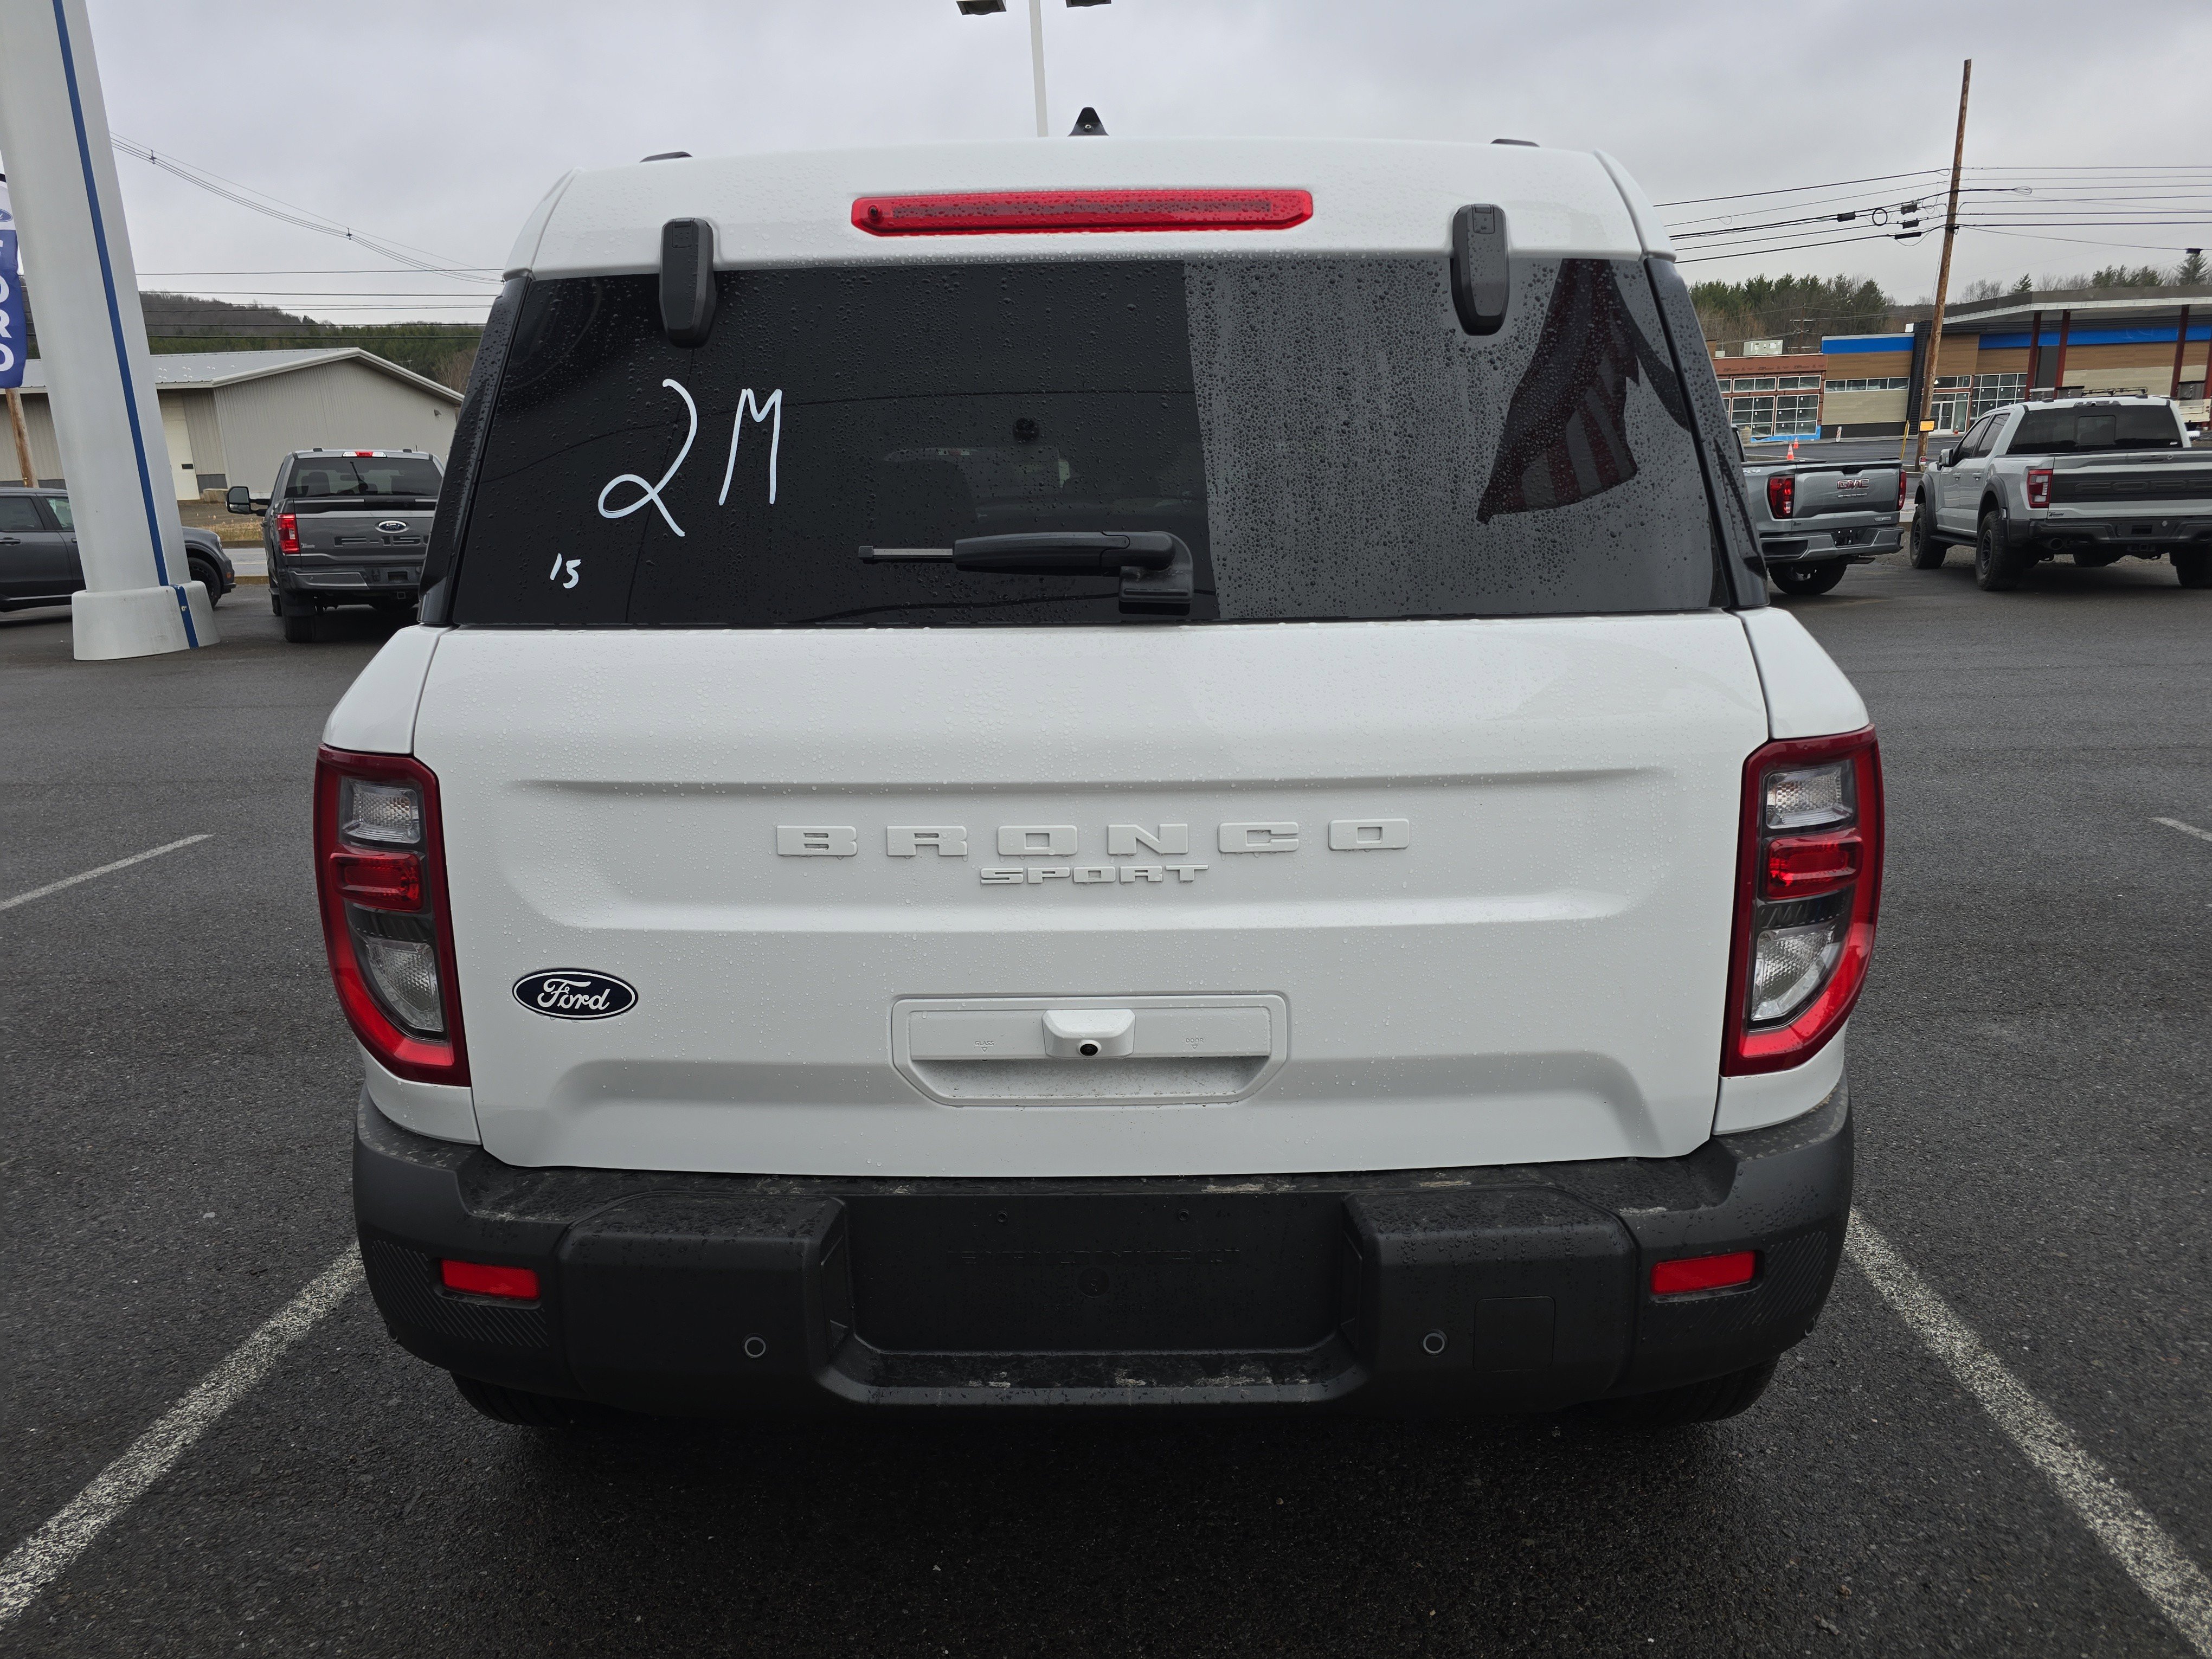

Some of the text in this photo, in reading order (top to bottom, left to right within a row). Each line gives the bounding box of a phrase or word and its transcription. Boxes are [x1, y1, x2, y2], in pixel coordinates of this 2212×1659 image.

[1837, 478, 1869, 490] GMC
[550, 553, 581, 589] 15
[776, 818, 1410, 857] BRONCO
[981, 864, 1209, 885] SPORT
[537, 978, 610, 1010] Ford
